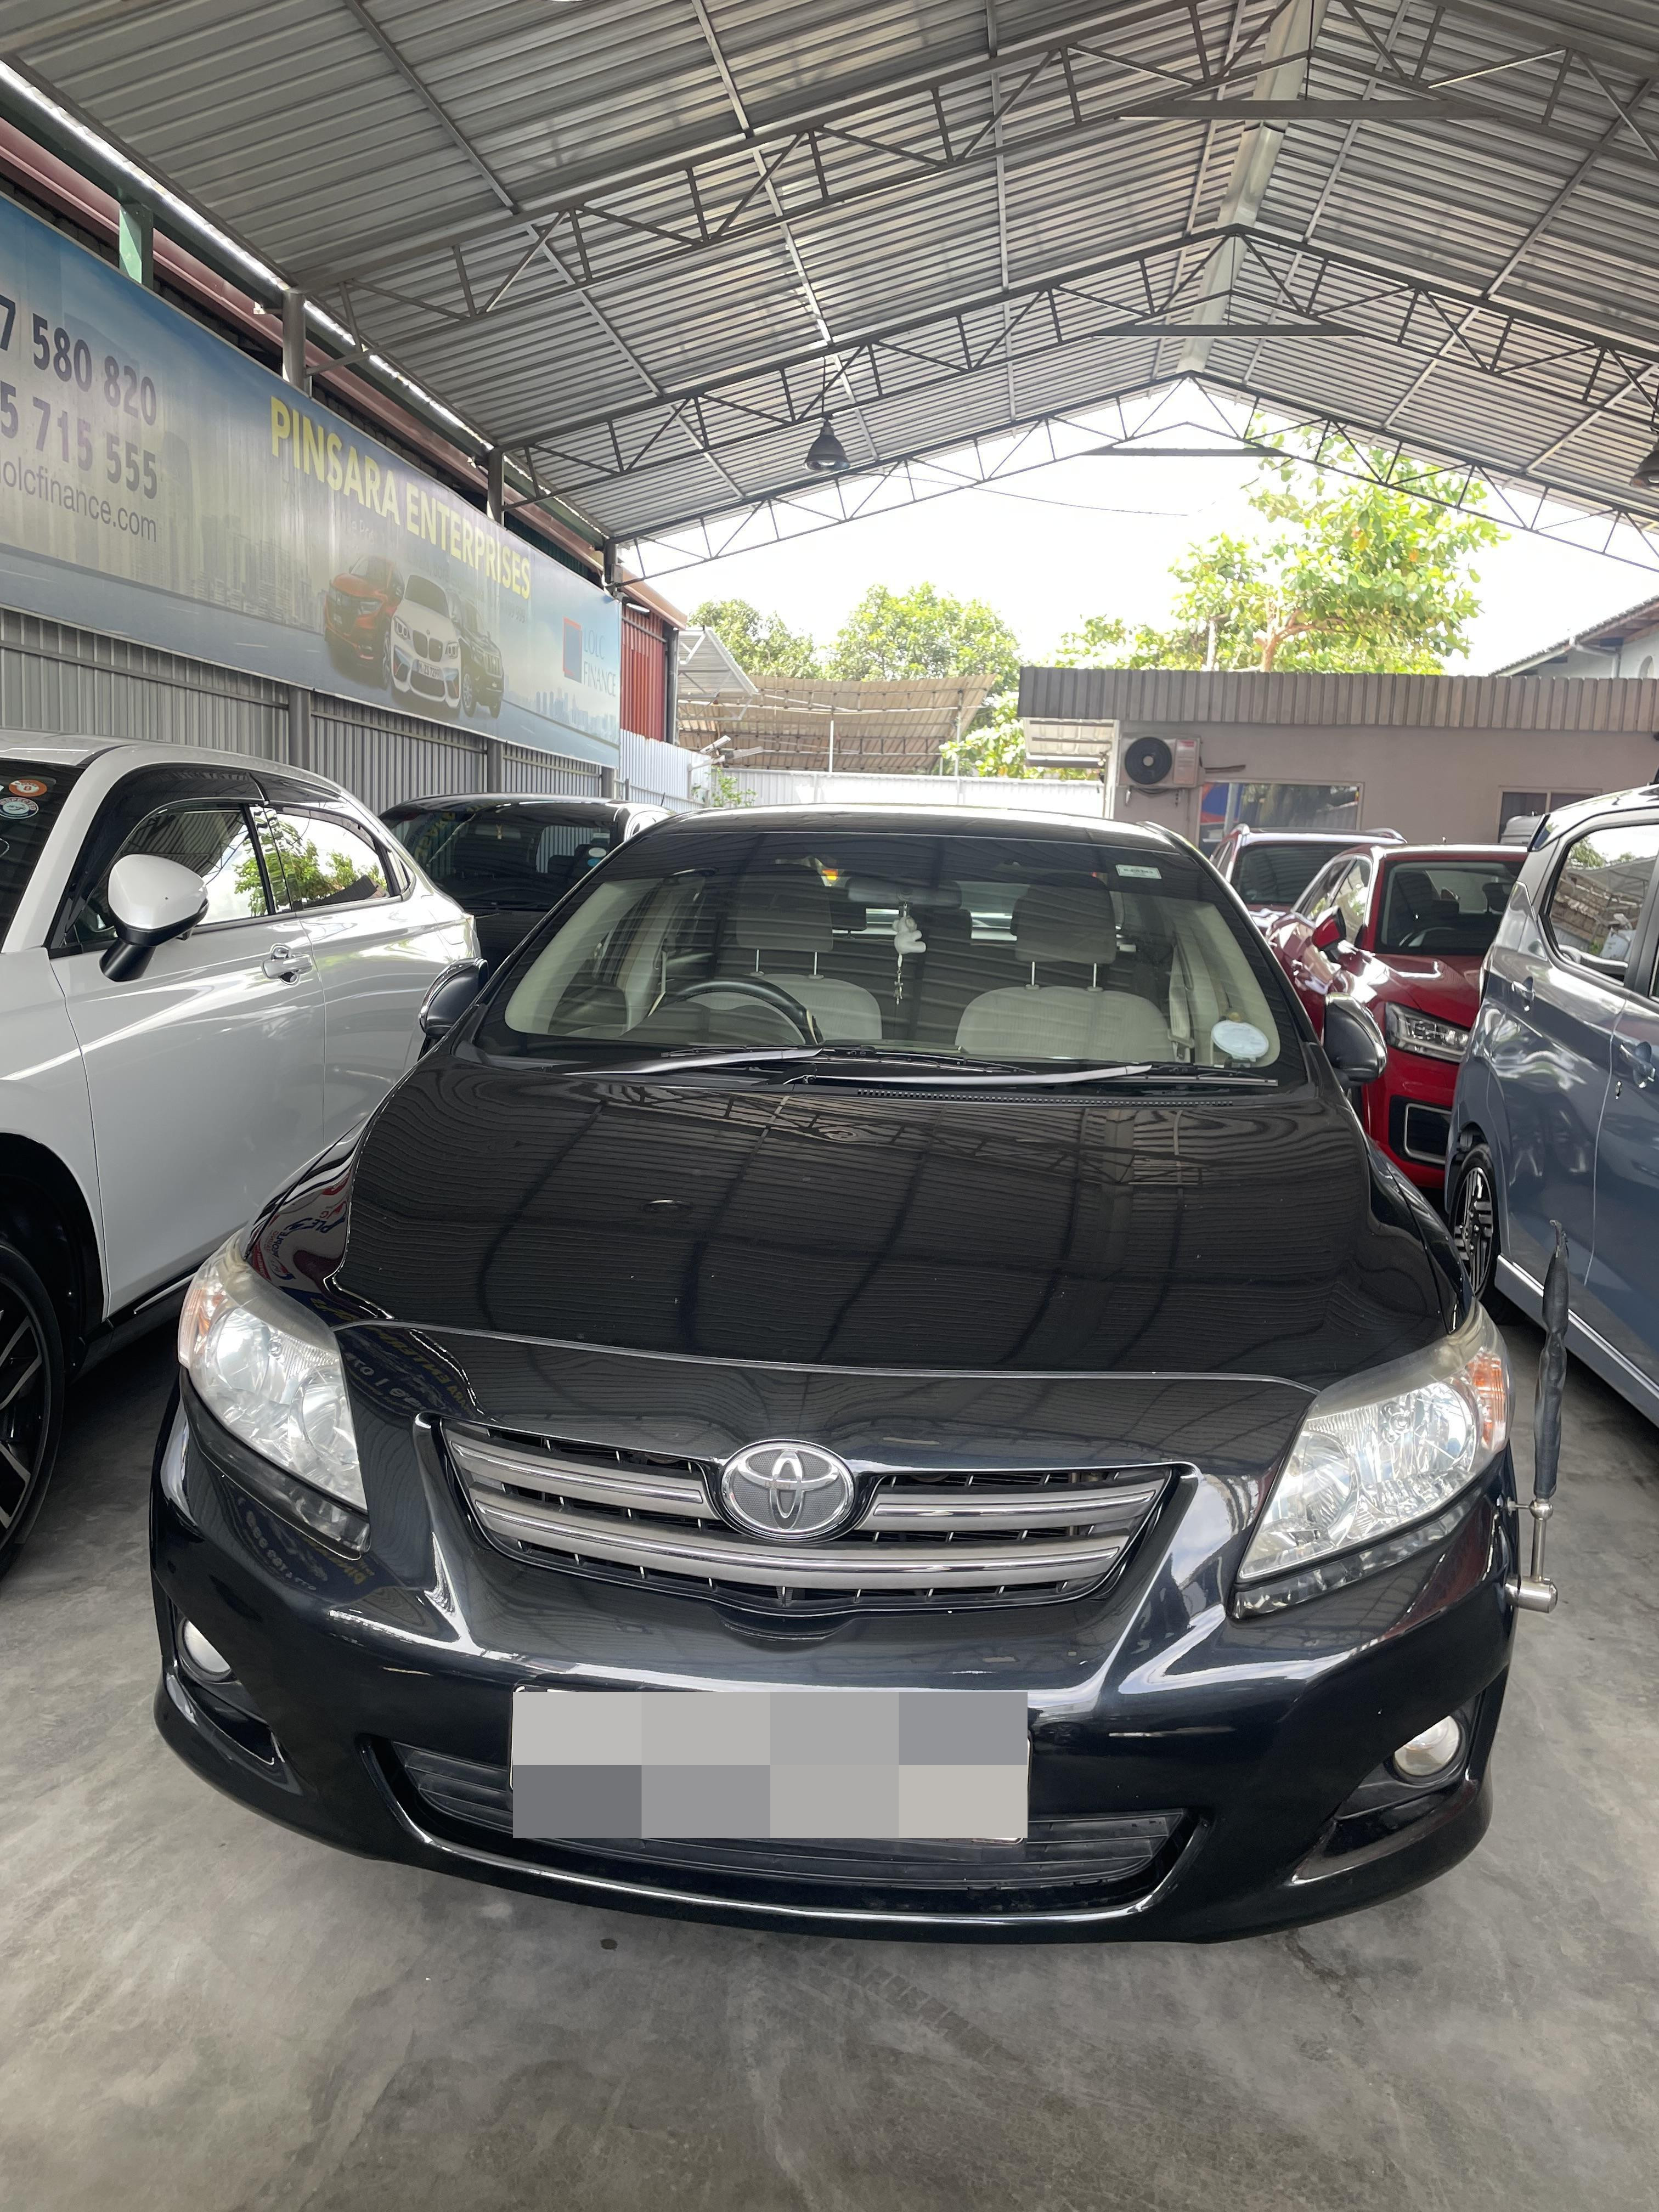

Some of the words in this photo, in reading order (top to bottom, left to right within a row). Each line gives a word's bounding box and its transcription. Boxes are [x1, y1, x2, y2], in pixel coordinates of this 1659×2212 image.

[33, 313, 92, 392] 580
[104, 356, 157, 426] 820
[33, 396, 93, 471] 715
[106, 432, 157, 499] 555
[0, 455, 156, 542] olcfinance.com
[271, 397, 400, 525] PINSARA
[407, 482, 531, 599] ENTERPRISES
[584, 628, 605, 660] LOLC
[584, 661, 616, 697] FINANCE
